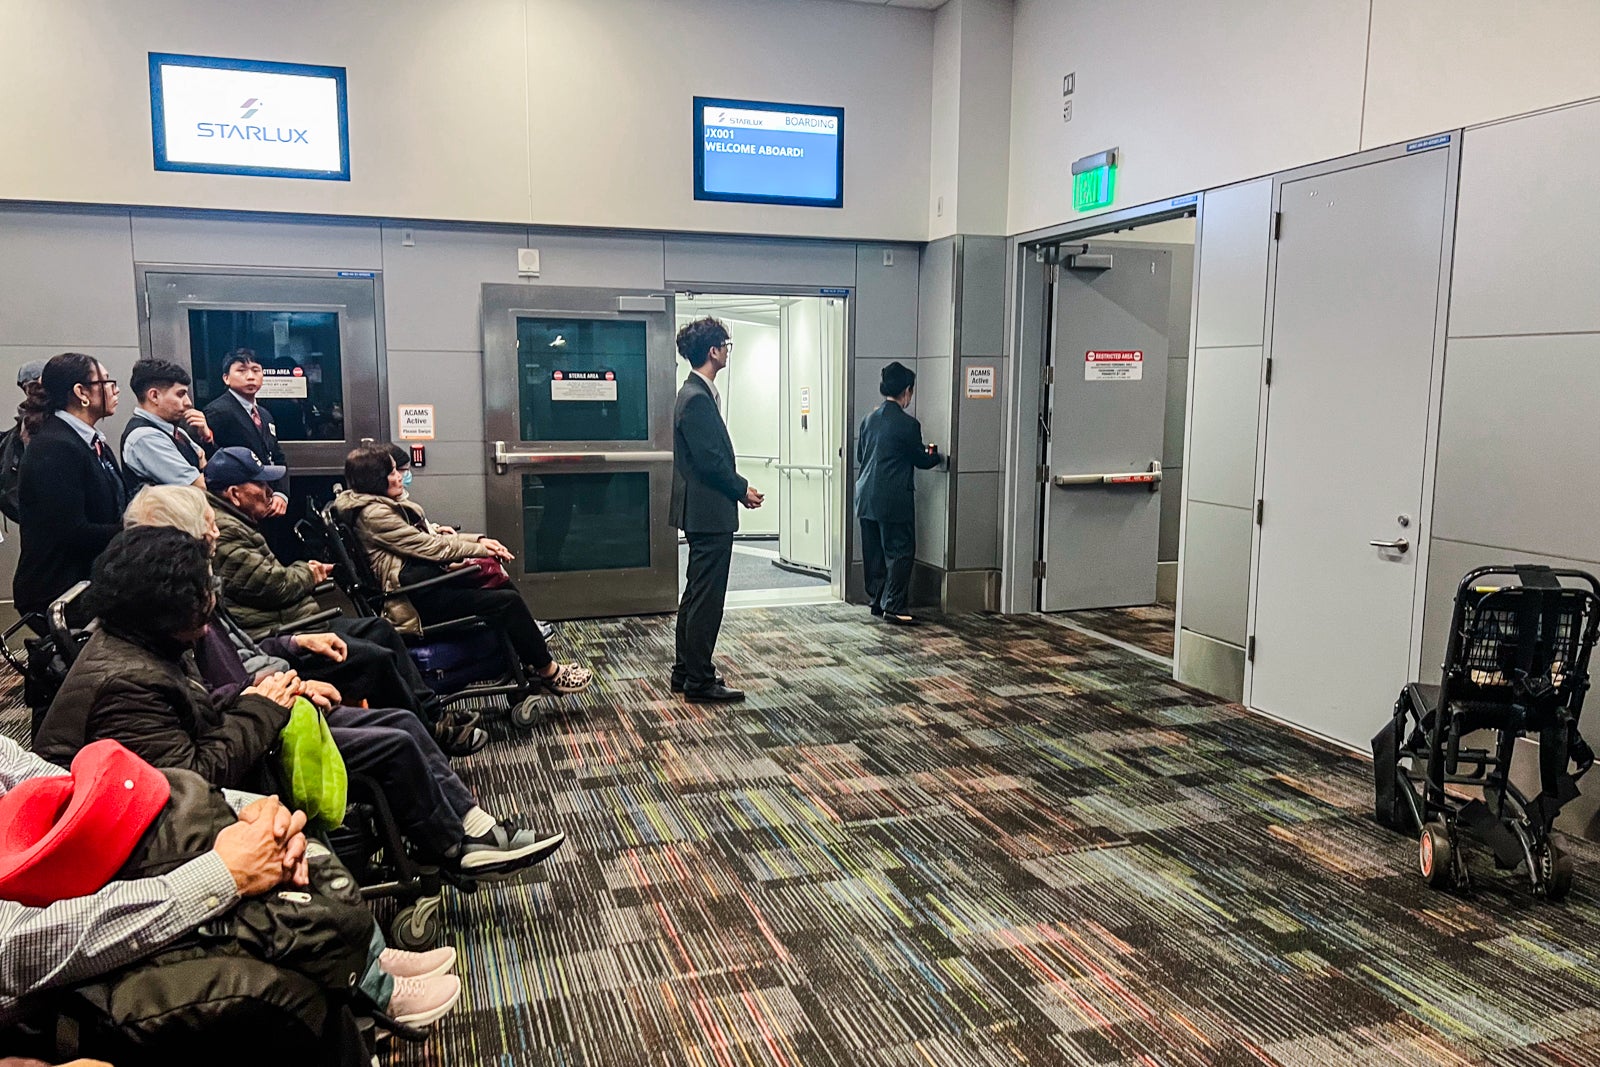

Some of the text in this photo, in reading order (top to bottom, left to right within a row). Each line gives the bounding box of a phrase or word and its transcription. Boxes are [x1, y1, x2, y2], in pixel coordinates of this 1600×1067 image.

[729, 117, 763, 126] STARLUX
[785, 116, 835, 129] BOARDING
[197, 122, 309, 144] STARLUX
[704, 128, 735, 139] JX001
[704, 141, 804, 158] WELCOME ABOARD!
